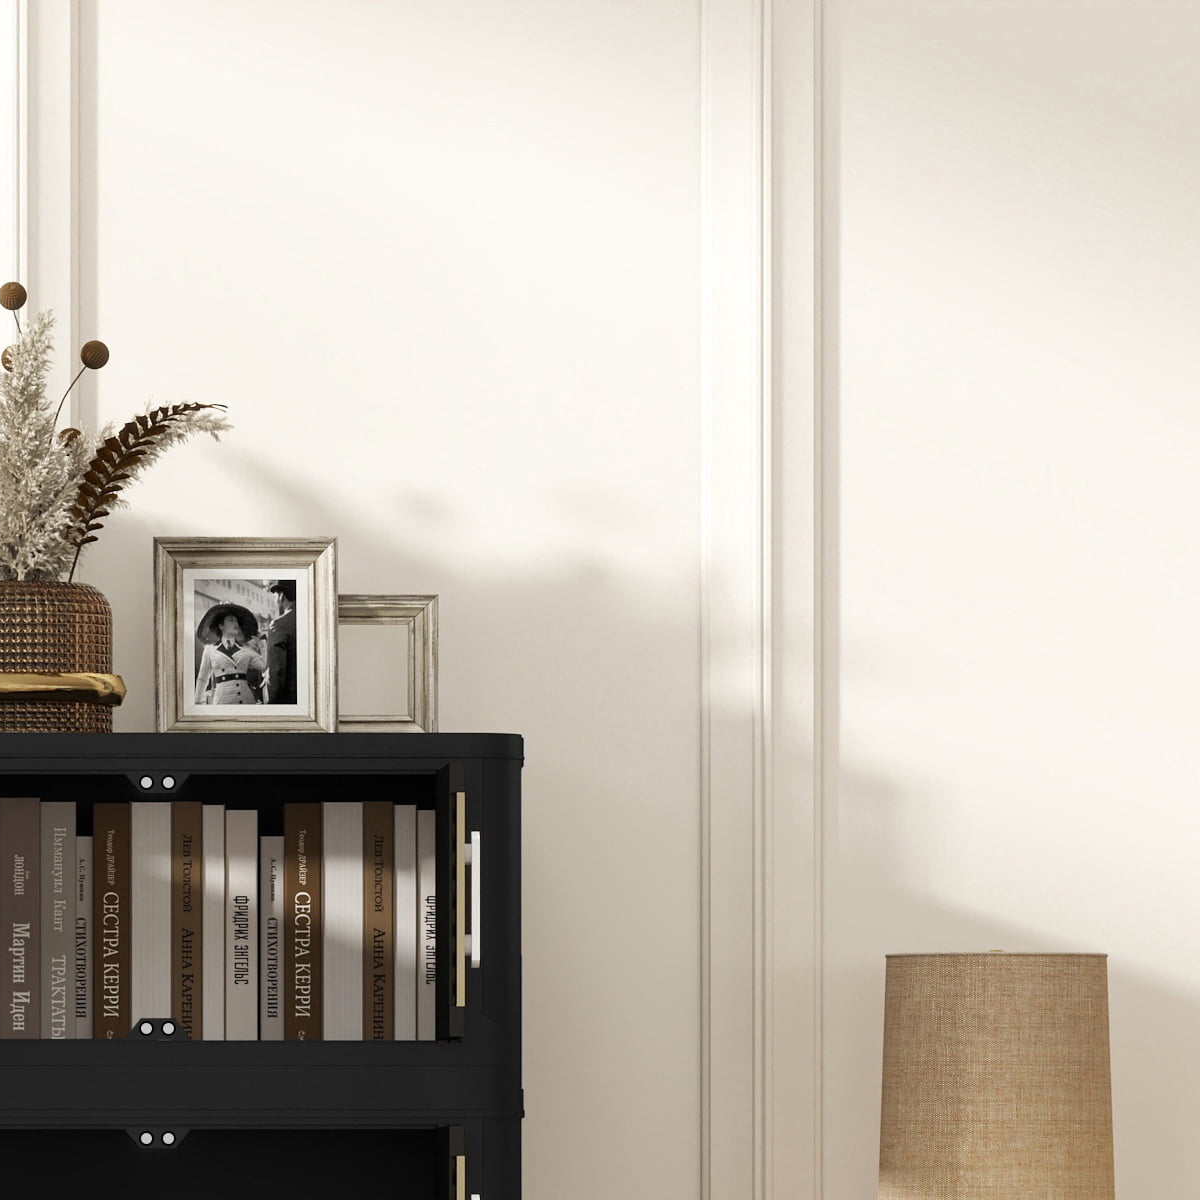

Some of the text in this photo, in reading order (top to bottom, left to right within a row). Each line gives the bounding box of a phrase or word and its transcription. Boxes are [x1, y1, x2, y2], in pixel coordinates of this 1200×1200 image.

[51, 827, 66, 932] Иммануил Кант
[75, 917, 86, 1017] СТИХОТВОРЕНИЯ
[103, 892, 119, 957] СЕСТРА
[233, 896, 250, 984] ФРИДРИХ ЭНГЕЛЬС
[267, 918, 278, 1018] СТИХОТВОРЕНИЯ
[294, 892, 311, 958] СЕСТРА
[9, 923, 30, 1031] Мартин Иден
[103, 963, 119, 1017] КЕРРИ
[294, 963, 310, 1017] КЕРРИ
